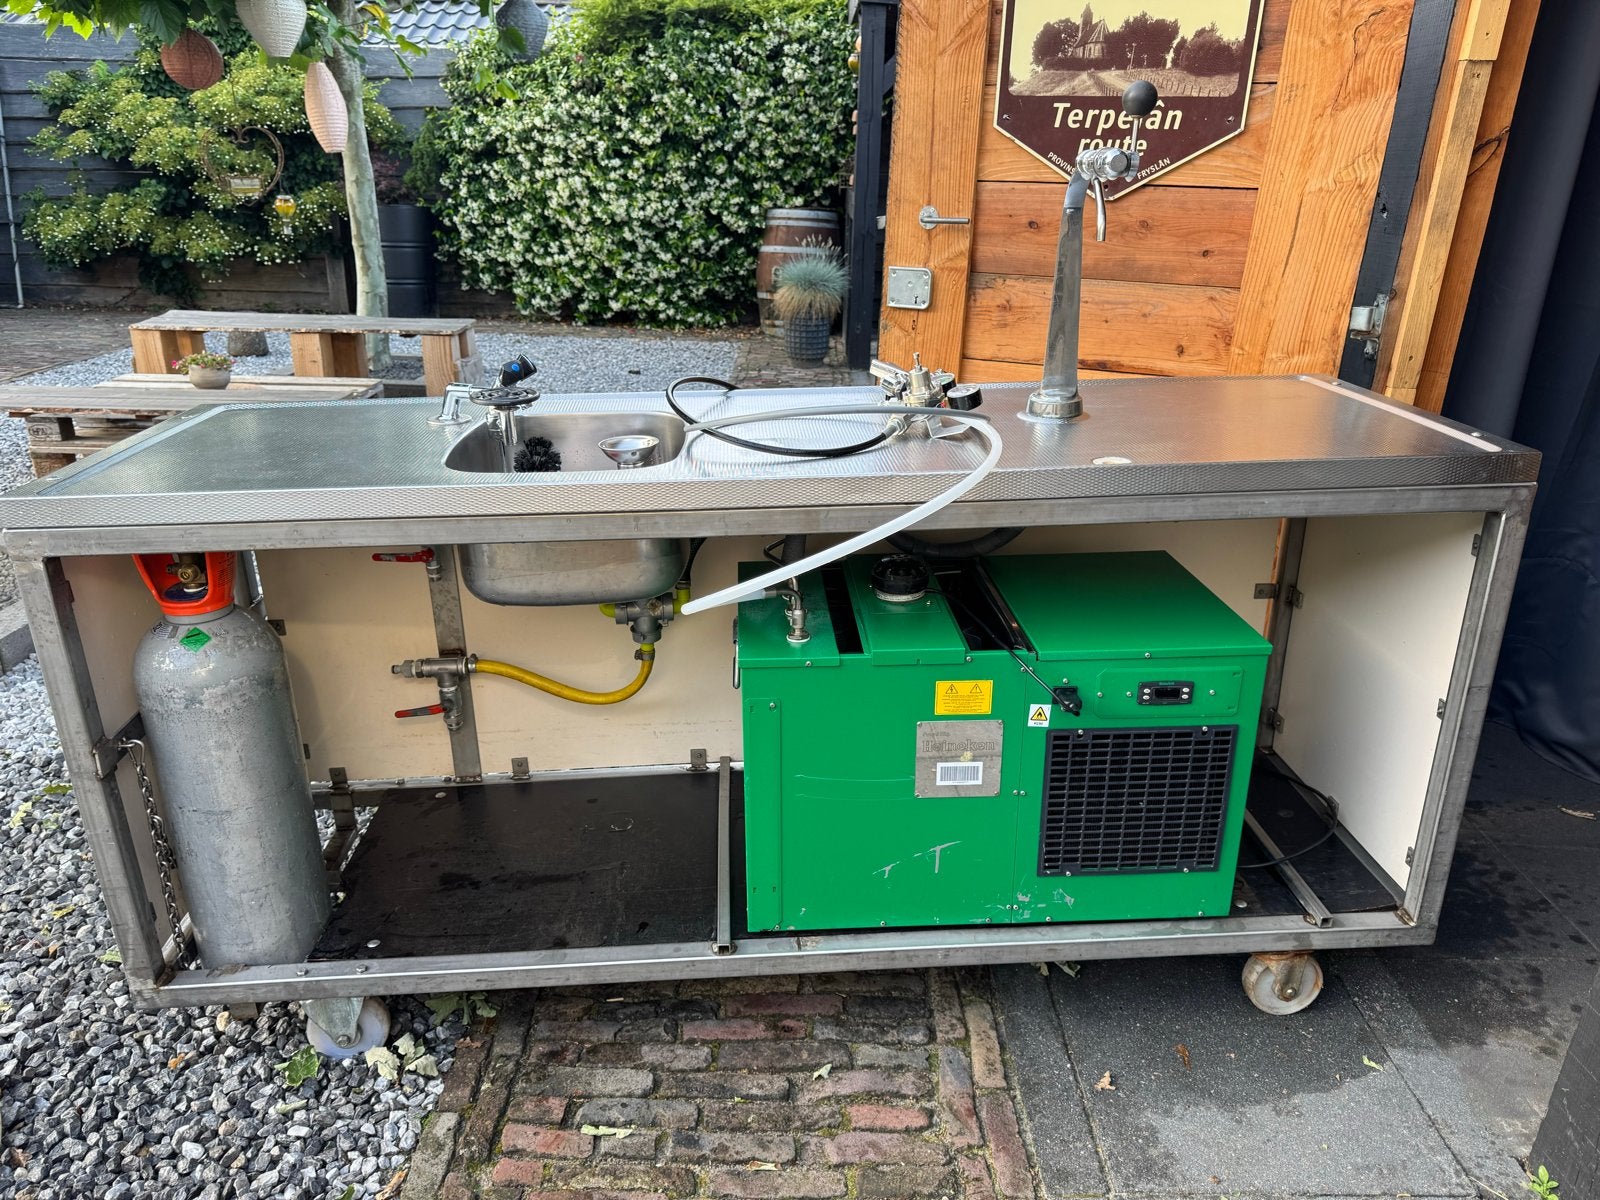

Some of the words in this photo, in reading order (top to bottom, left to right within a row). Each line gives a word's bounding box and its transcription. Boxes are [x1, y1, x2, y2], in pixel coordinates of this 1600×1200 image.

[1053, 99, 1183, 136] Terpeân
[1136, 157, 1171, 180] FRYSLÂN
[922, 739, 995, 752] Heineken
